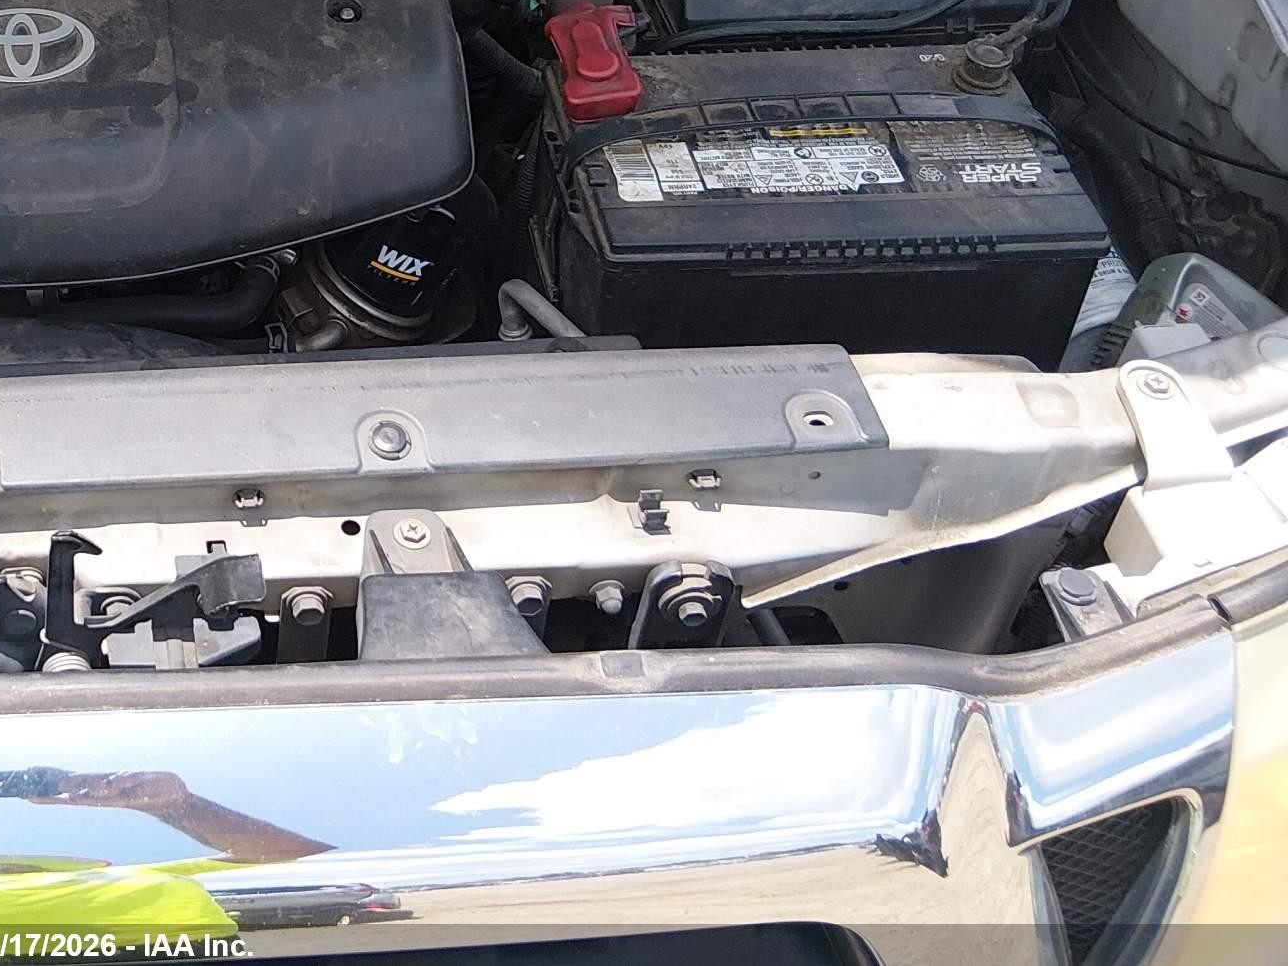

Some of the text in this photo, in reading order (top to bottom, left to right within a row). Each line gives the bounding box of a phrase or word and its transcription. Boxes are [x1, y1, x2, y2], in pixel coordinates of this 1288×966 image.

[958, 162, 1042, 175] START
[961, 173, 1037, 183] SUPER
[750, 184, 850, 194] DANGER/POISON
[377, 244, 431, 277] WIX
